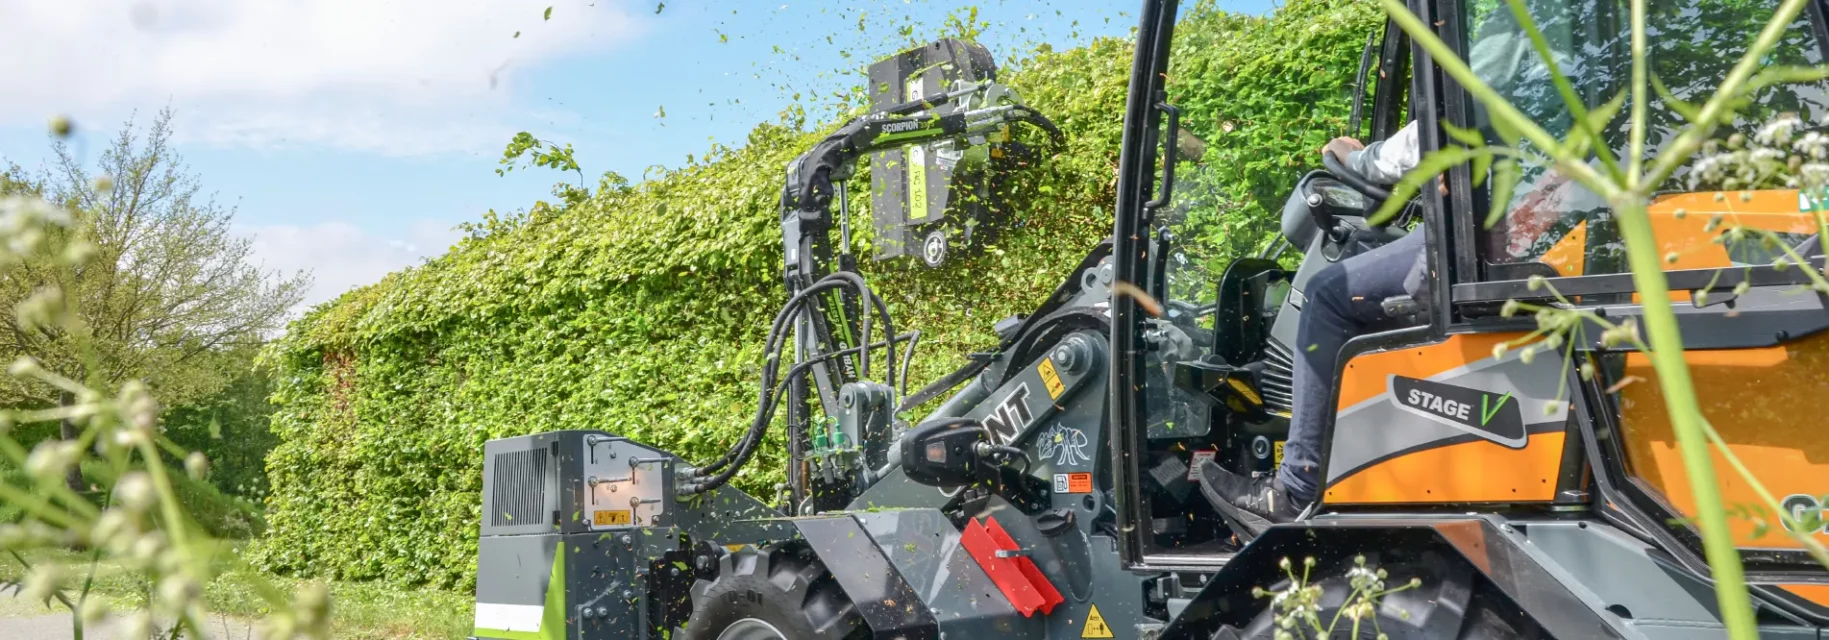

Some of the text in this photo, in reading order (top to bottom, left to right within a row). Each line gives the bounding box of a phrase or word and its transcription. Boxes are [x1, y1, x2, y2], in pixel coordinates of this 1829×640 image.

[881, 120, 919, 133] SCORPION
[914, 188, 923, 209] 102
[1408, 389, 1512, 427] STAGE V
